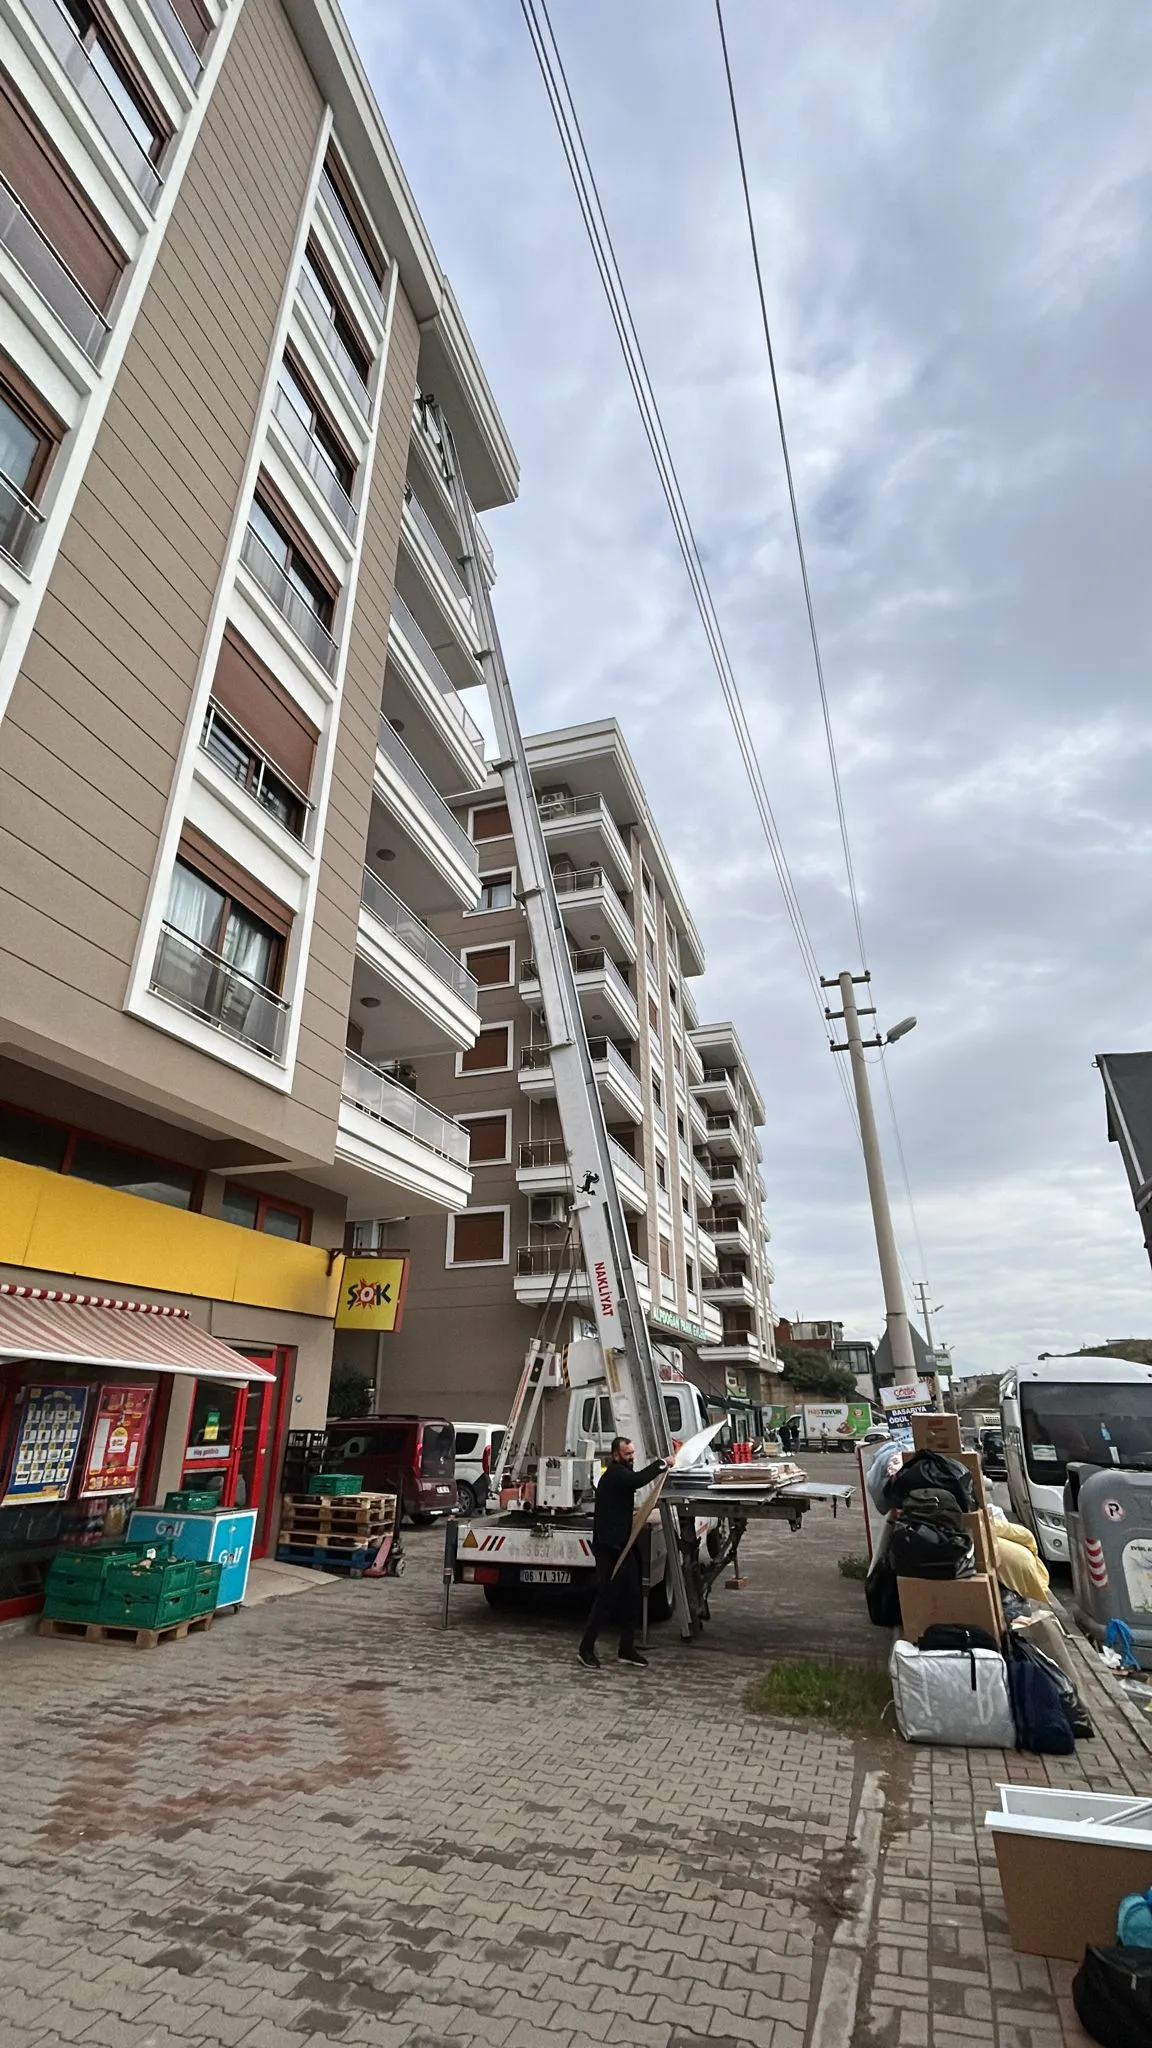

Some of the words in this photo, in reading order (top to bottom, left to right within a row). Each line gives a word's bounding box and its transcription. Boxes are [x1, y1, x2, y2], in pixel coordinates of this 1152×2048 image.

[347, 1282, 391, 1310] ŞOK
[594, 1262, 614, 1317] NAKLİYAT
[155, 1520, 185, 1538] Golf
[218, 1546, 244, 1566] Golf
